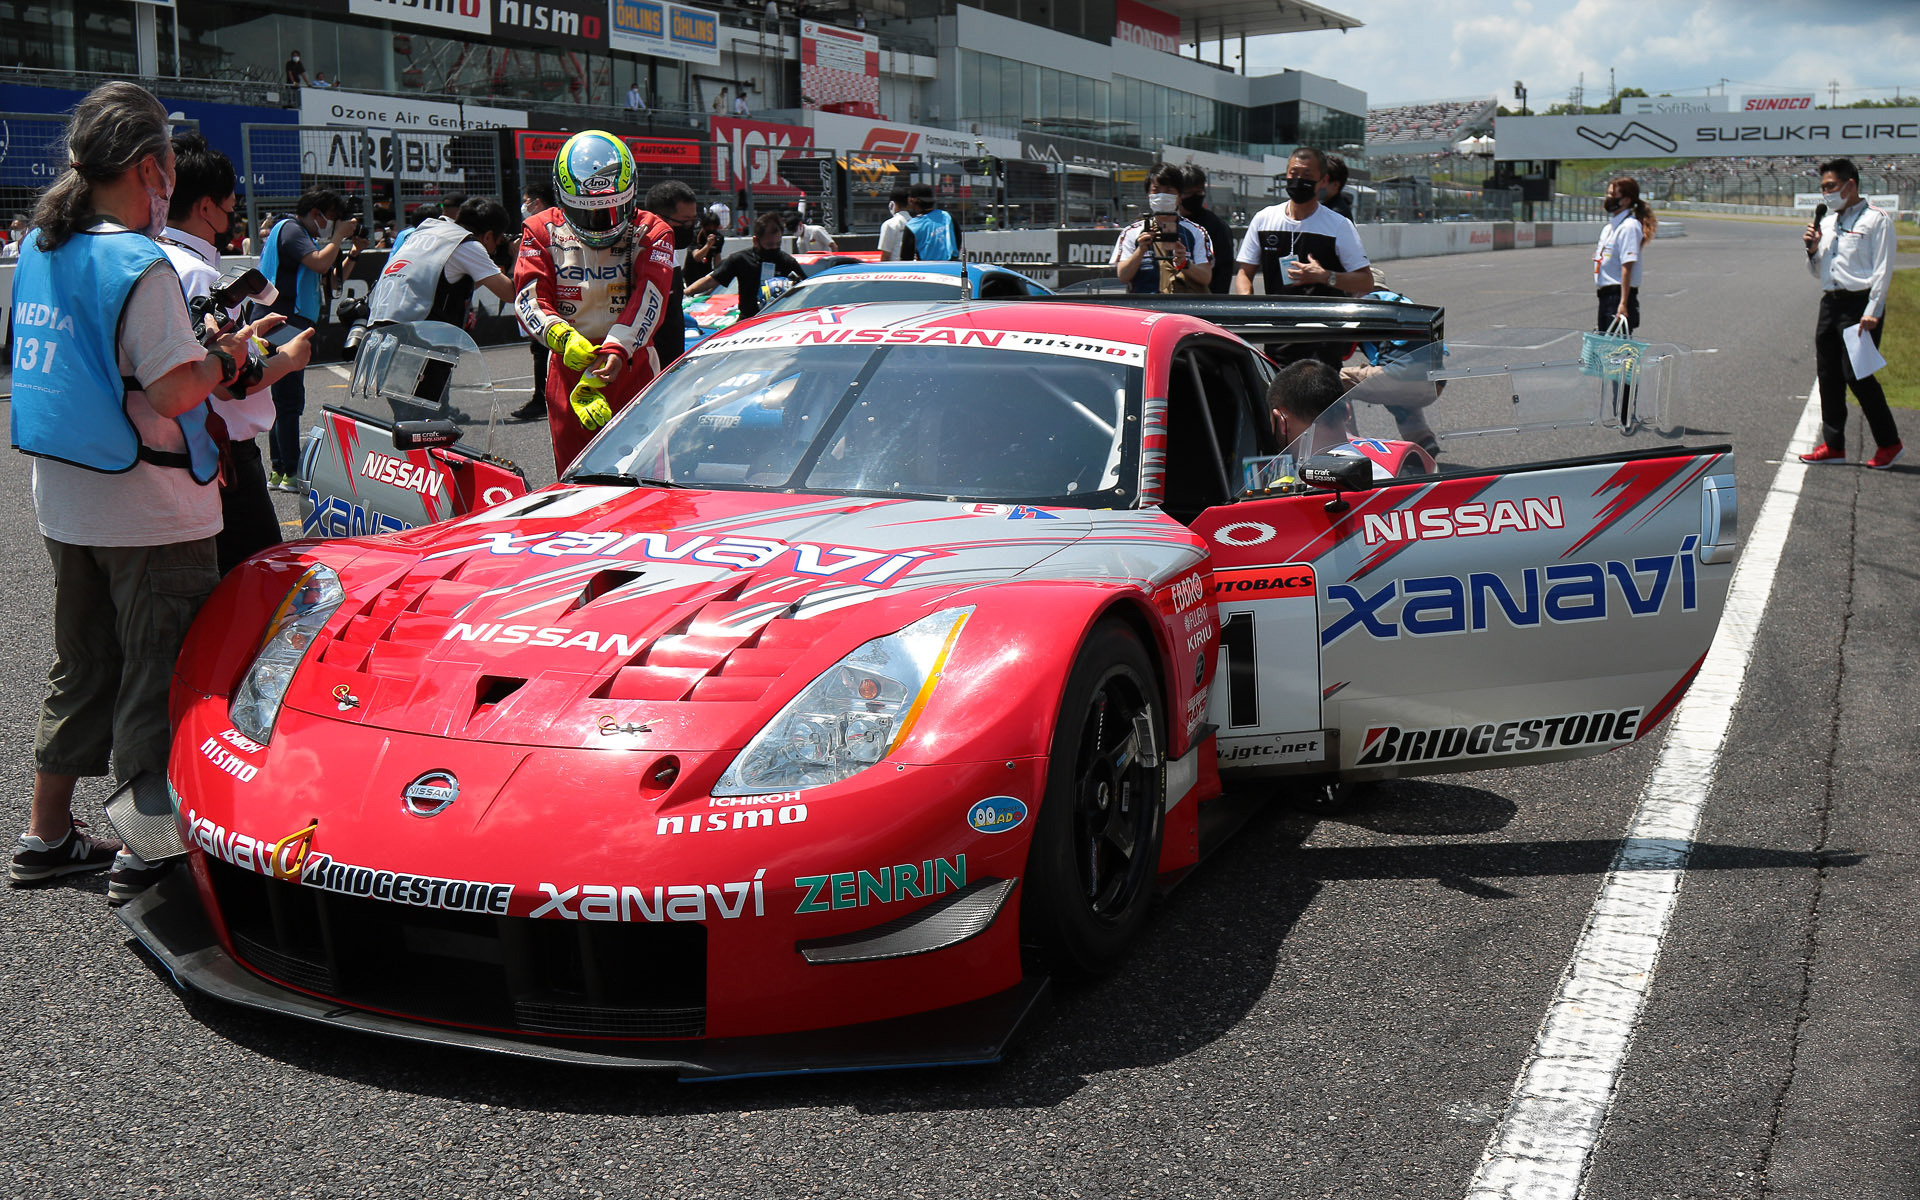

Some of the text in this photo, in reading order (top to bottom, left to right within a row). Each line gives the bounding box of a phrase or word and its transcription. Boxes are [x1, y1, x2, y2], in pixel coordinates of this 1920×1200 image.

[500, 0, 601, 40] nismo
[673, 11, 715, 42] ÖHLINS
[1119, 20, 1177, 54] HONDA
[331, 104, 388, 122] Ozone
[394, 111, 421, 124] Air
[1656, 102, 1712, 113] SoftBank
[1745, 97, 1811, 111] SUNOCO
[1696, 123, 1919, 142] SUZUKA CIRC
[639, 145, 687, 156] AUTOBACS
[716, 126, 792, 188] NGK
[589, 178, 608, 189] Arai
[579, 198, 618, 207] NISSAN
[15, 301, 75, 338] MEDIA
[15, 336, 58, 374] 131
[704, 329, 1127, 357] nismo NISSAN nismo
[361, 451, 444, 498] NISSAN
[1362, 496, 1566, 546] NISSAN
[1171, 572, 1203, 614] EBBRO
[443, 621, 648, 657] NISSAN
[1187, 624, 1212, 653] KIRIU
[1218, 610, 1259, 729] 1
[219, 728, 265, 754] ICHIKOH
[1354, 706, 1645, 769] BRIDGESTONE
[200, 736, 259, 783] nismo
[408, 786, 452, 799] NISSAN
[708, 792, 802, 808] ICHIKOH
[656, 803, 809, 836] nismo
[302, 852, 515, 916] BRIDGESTONE
[794, 853, 968, 915] ZENRIN
